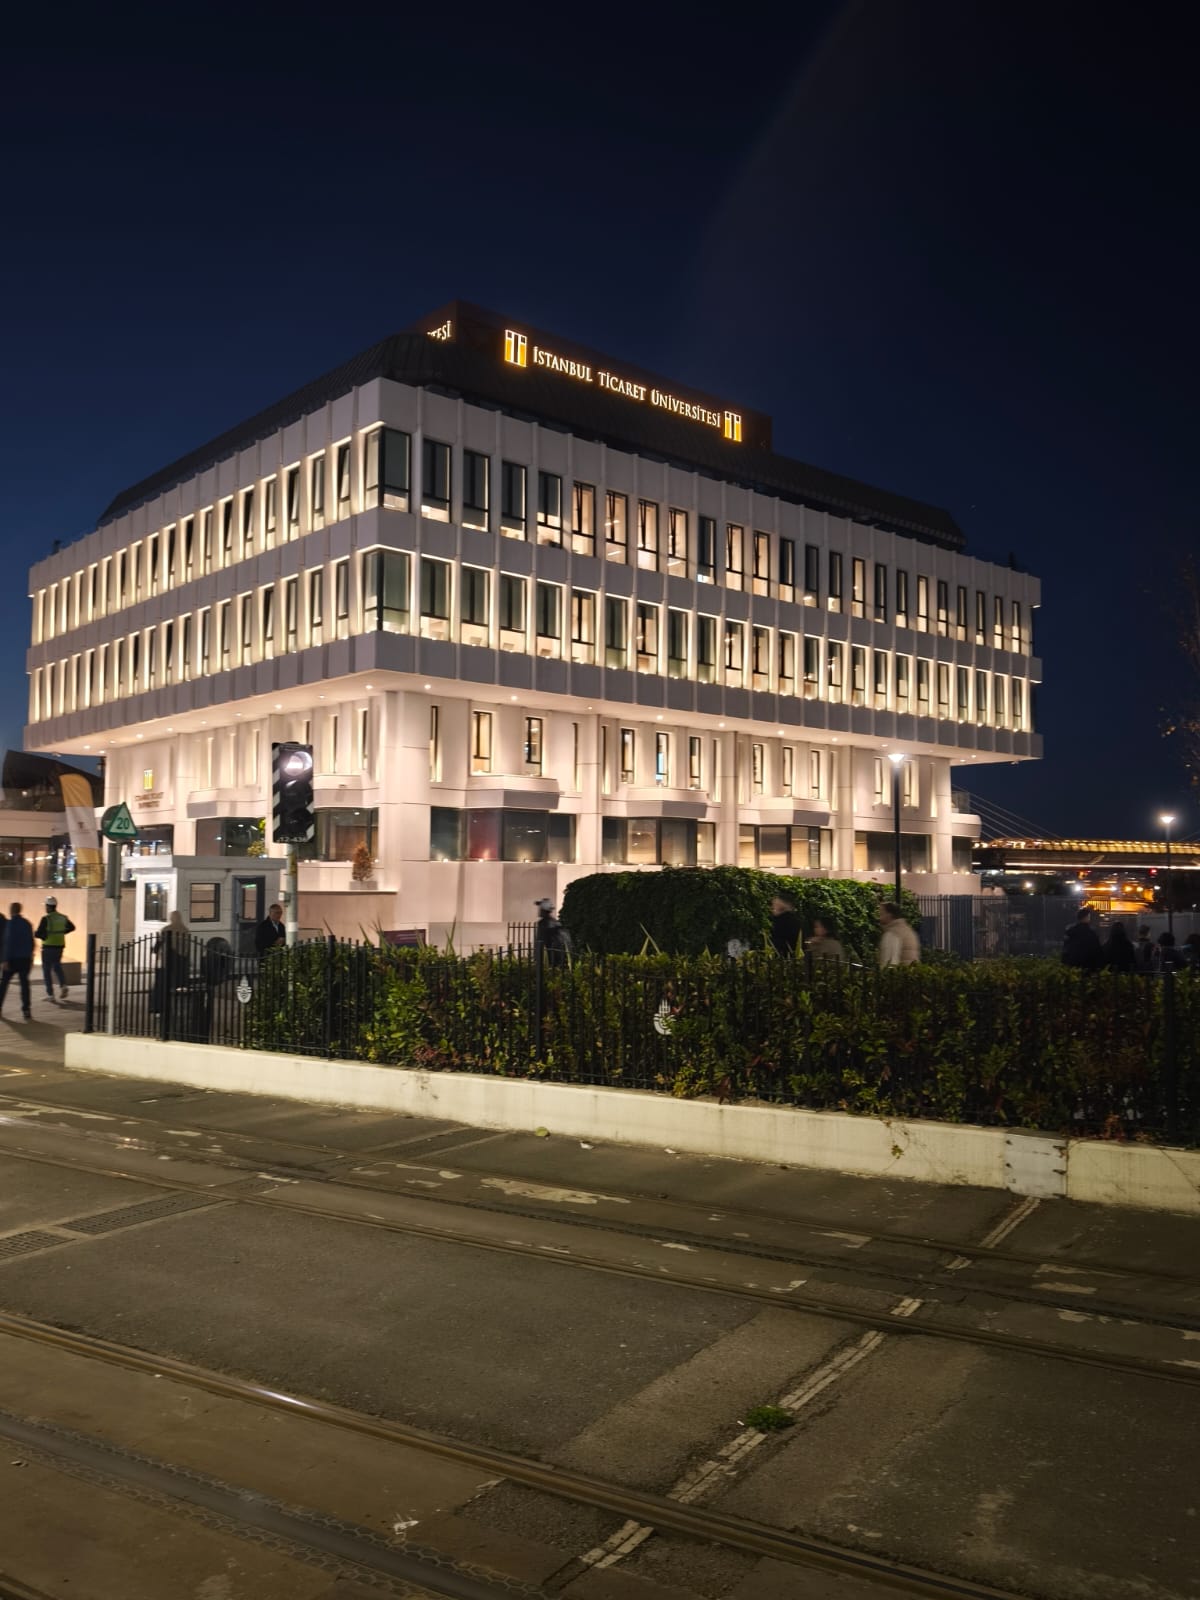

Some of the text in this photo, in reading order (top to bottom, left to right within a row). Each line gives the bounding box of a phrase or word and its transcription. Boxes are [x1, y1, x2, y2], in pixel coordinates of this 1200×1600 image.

[533, 346, 721, 428] İSTANBUL TİCARET ÜNİVERSİTESİ
[116, 817, 130, 830] 20
